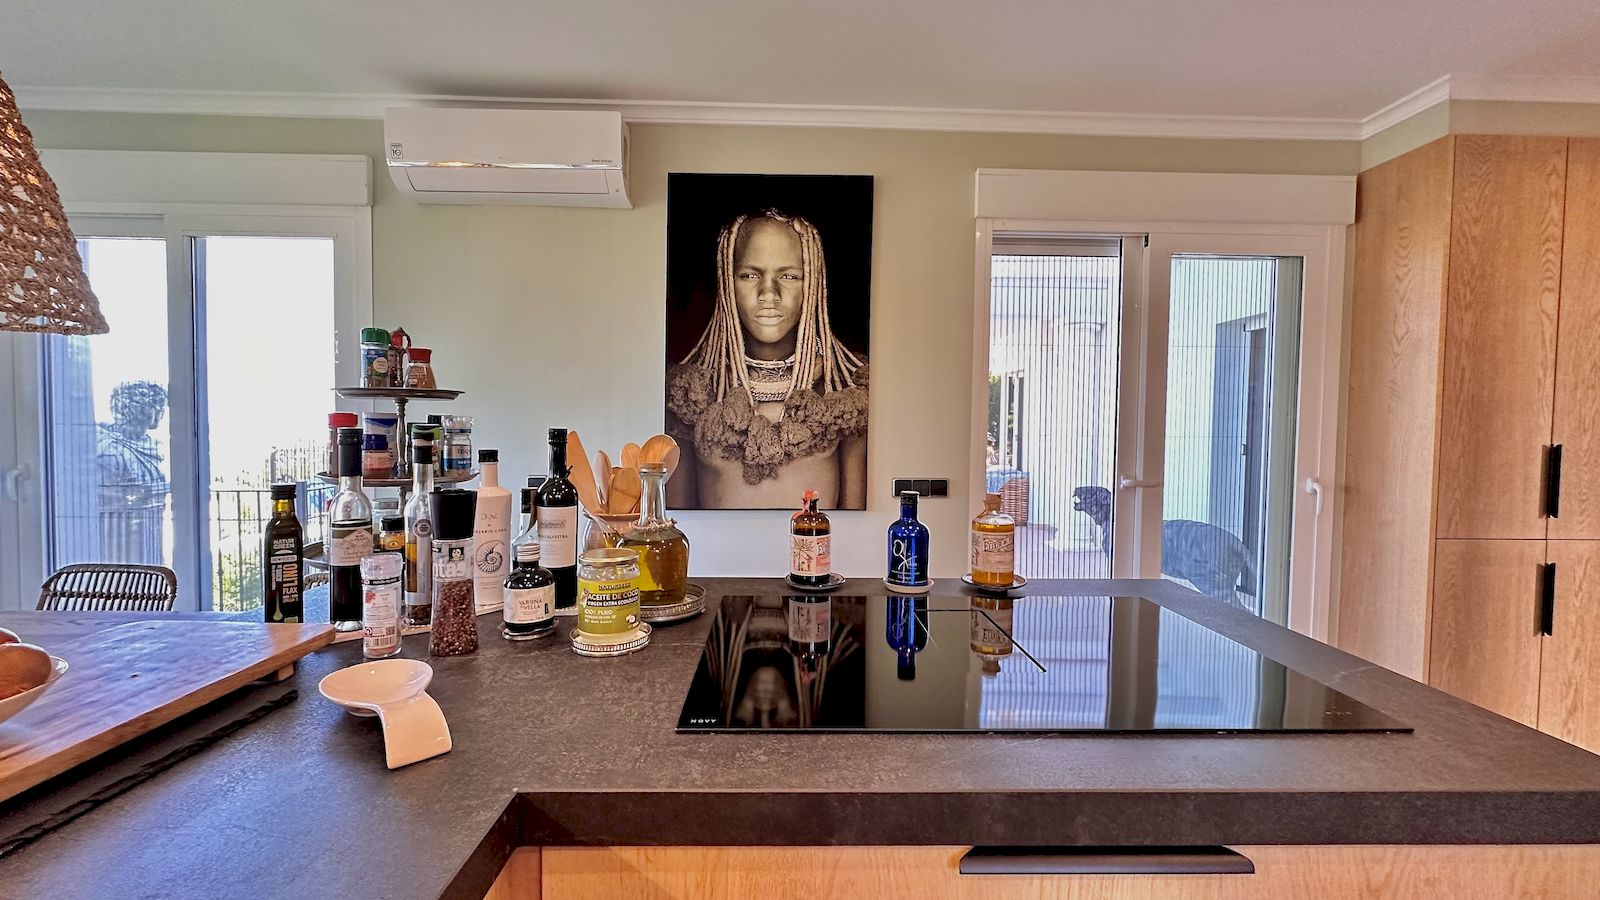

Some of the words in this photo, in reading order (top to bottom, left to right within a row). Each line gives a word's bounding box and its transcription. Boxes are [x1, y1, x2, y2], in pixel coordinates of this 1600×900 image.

[282, 587, 298, 595] FLAX
[587, 593, 611, 601] ACEITE
[612, 592, 622, 600] DE
[623, 588, 639, 598] COCO
